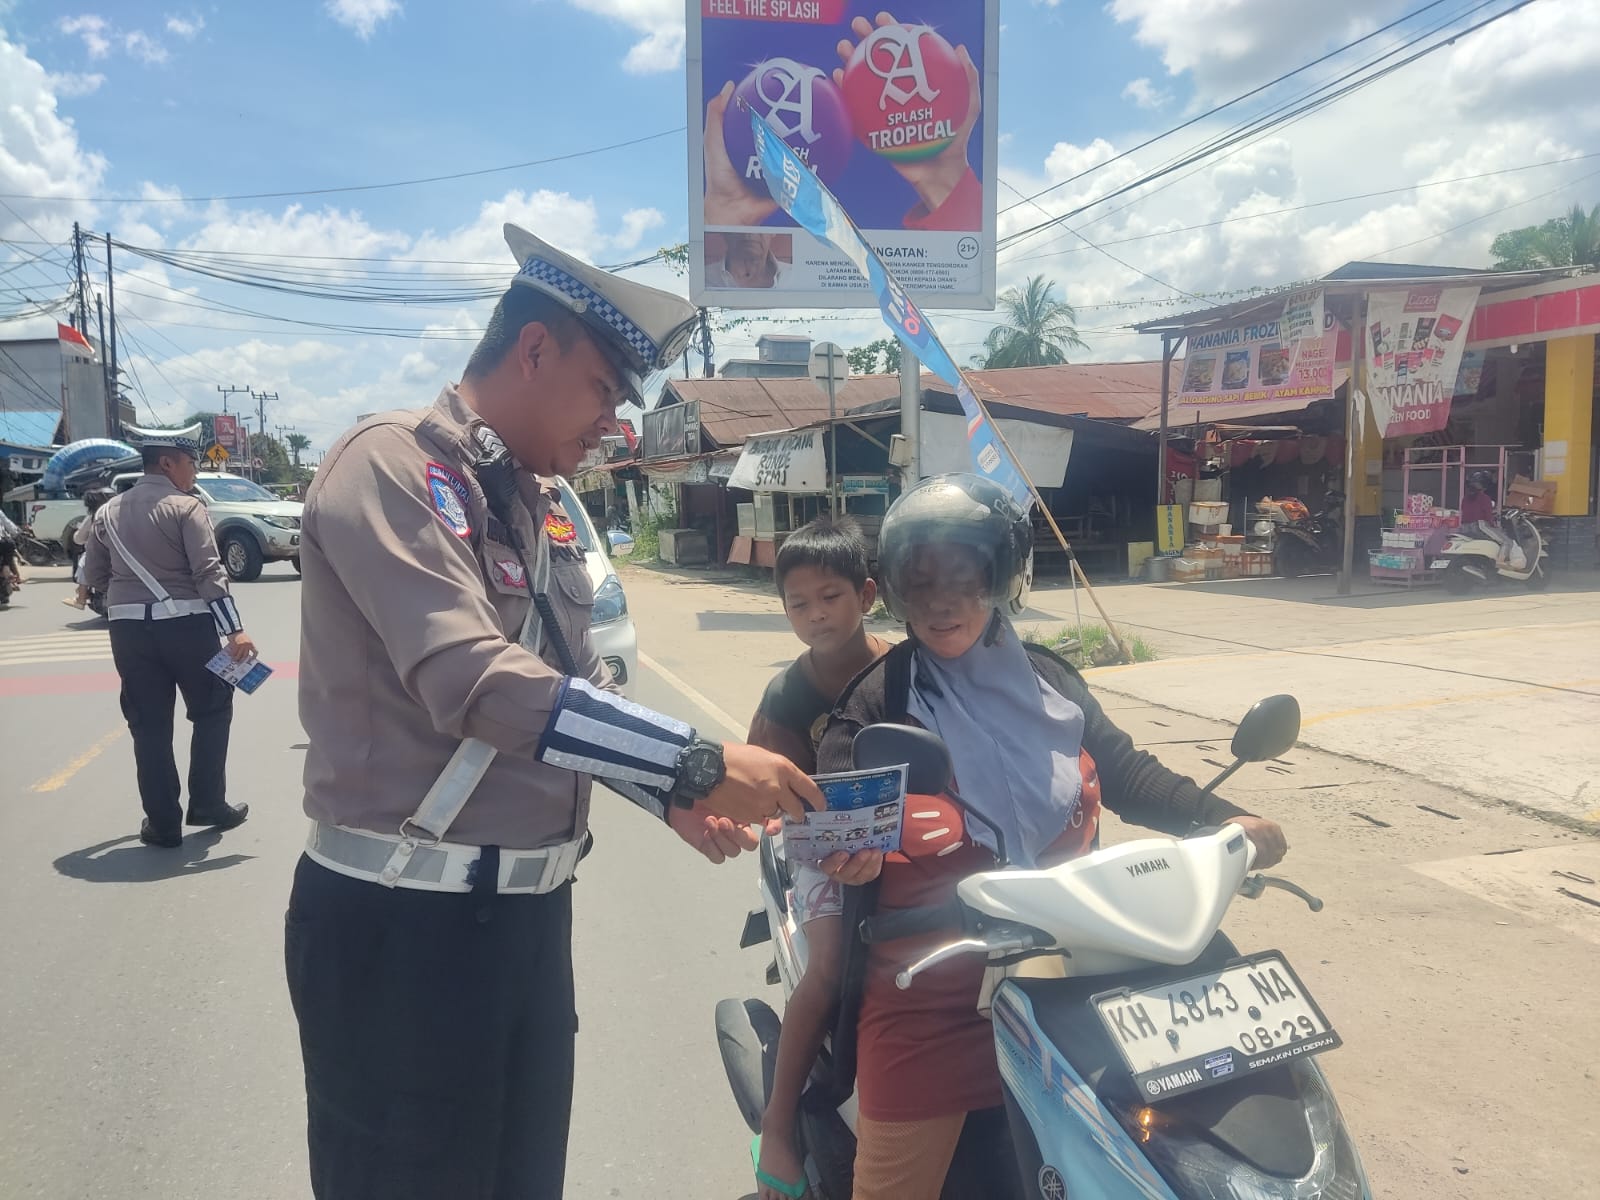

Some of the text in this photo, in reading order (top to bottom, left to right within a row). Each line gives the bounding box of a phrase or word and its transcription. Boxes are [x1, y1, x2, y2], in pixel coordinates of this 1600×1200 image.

[709, 0, 820, 20] FEEL THE SPLASH
[887, 107, 933, 126] SPLASH
[868, 118, 957, 151] TROPICAL
[1190, 330, 1241, 350] HANANIA
[1274, 388, 1298, 399] AYAM
[1405, 408, 1432, 422] FOOD
[1126, 857, 1170, 878] YAMAHA
[1107, 967, 1297, 1043] KH 4843 NA
[1157, 1068, 1203, 1093] YAMAHA
[1248, 1050, 1292, 1070] SEMAKIN
[1293, 1045, 1303, 1056] DI
[1302, 1036, 1335, 1053] DEPAN
